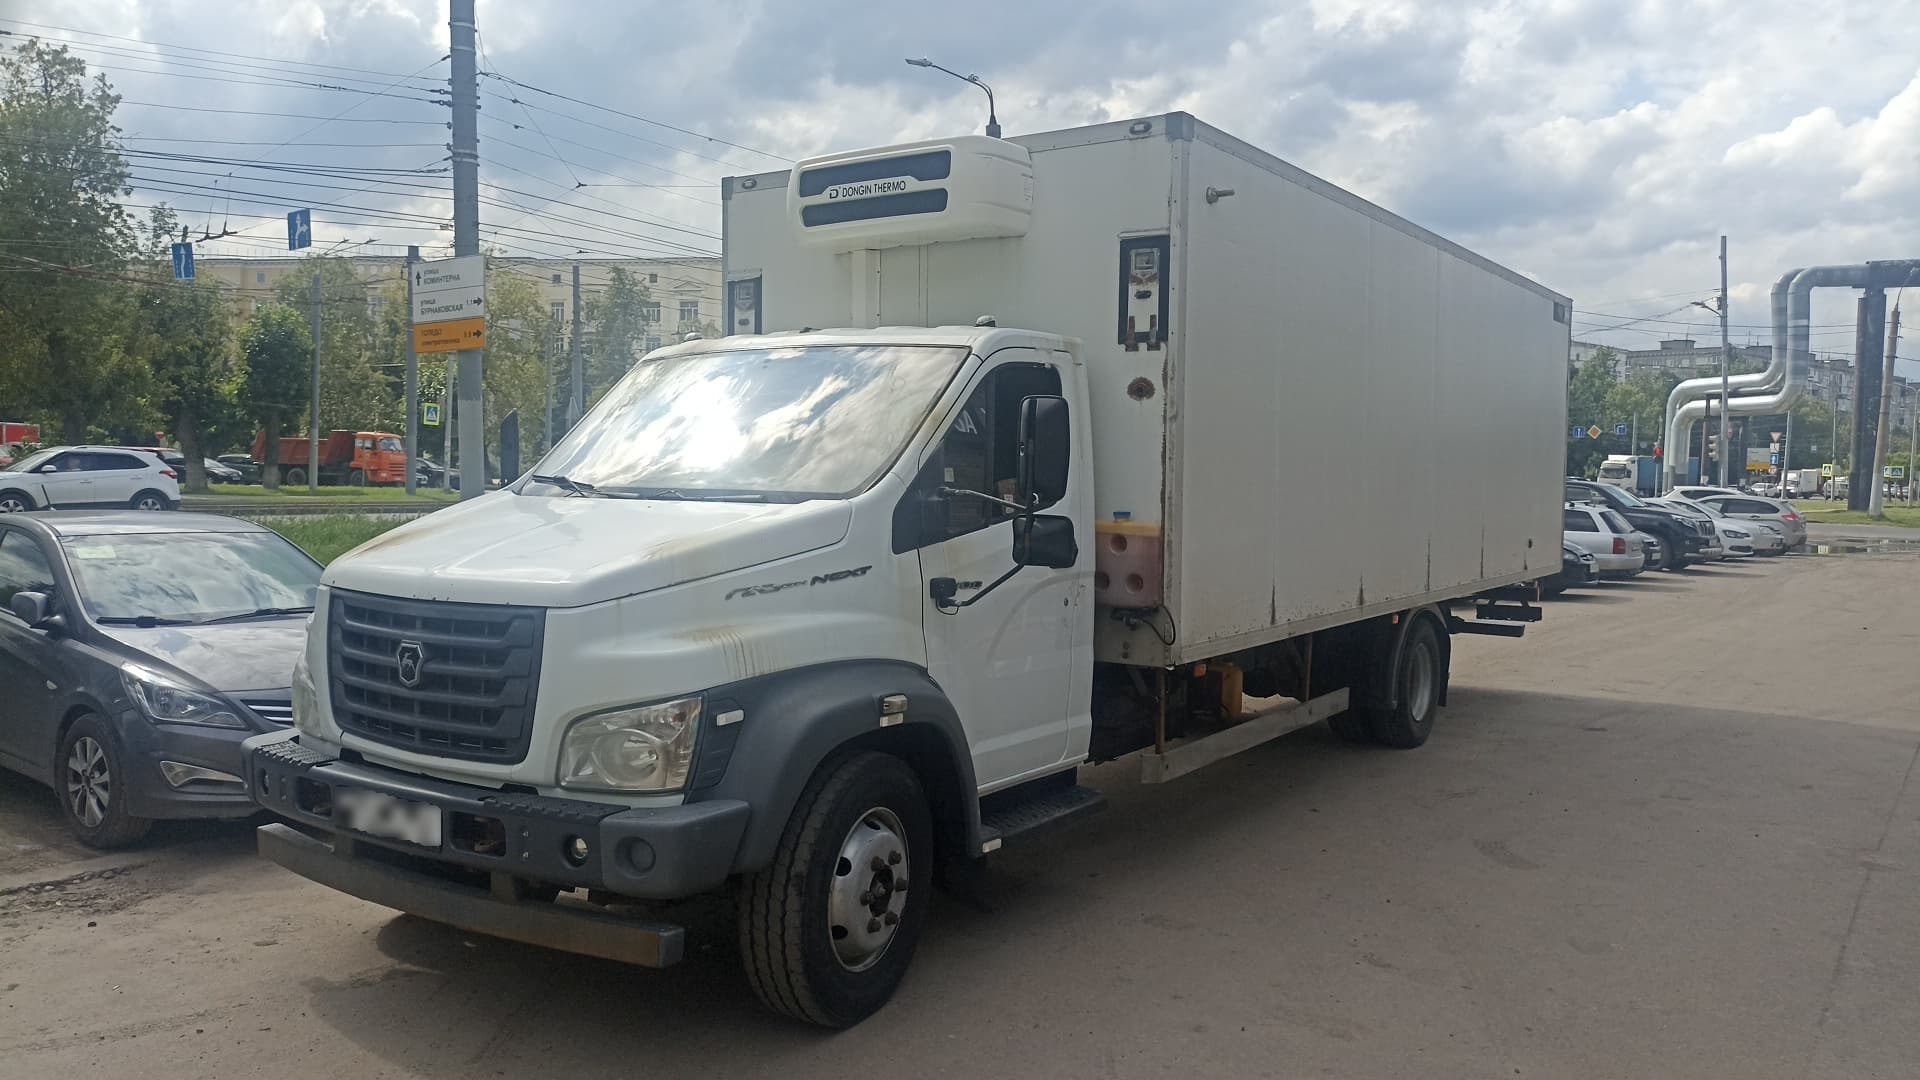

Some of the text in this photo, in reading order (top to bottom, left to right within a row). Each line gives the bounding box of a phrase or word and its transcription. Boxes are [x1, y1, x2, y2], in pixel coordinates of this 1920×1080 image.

[842, 184, 872, 198] DONGIN
[873, 181, 906, 193] THERMO
[810, 565, 873, 586] NEXT
